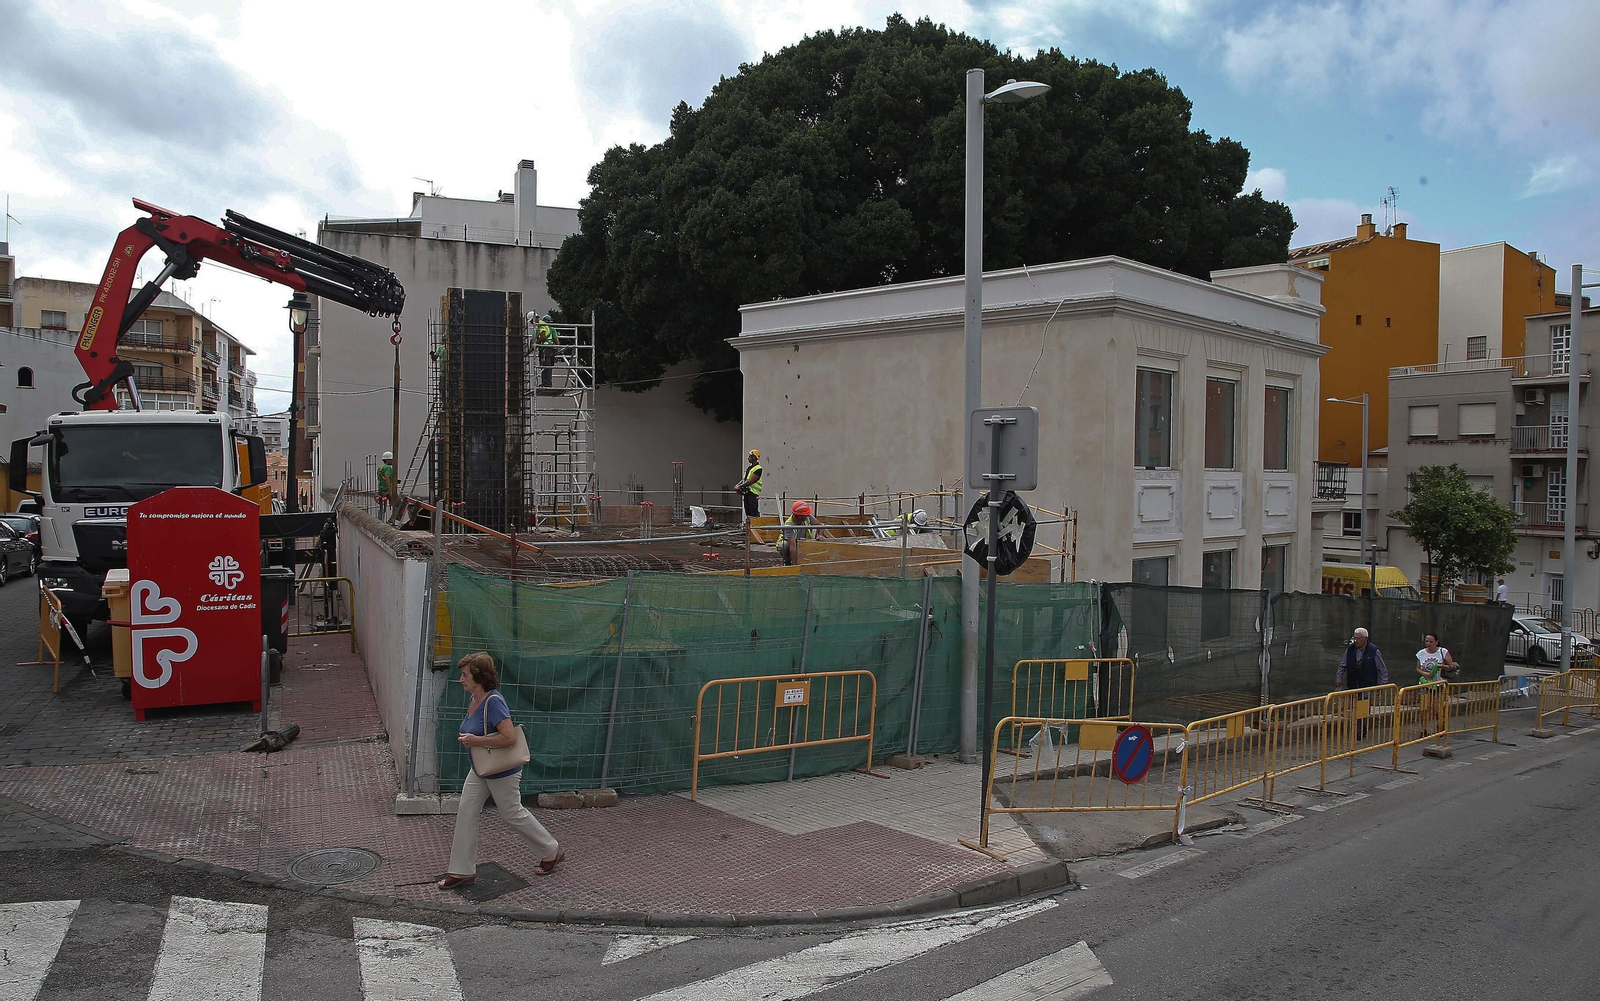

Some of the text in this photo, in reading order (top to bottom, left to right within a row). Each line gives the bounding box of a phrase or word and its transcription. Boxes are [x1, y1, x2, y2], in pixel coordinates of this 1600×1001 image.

[99, 257, 121, 303] PK 42002-SH
[200, 593, 253, 602] Cáritas
